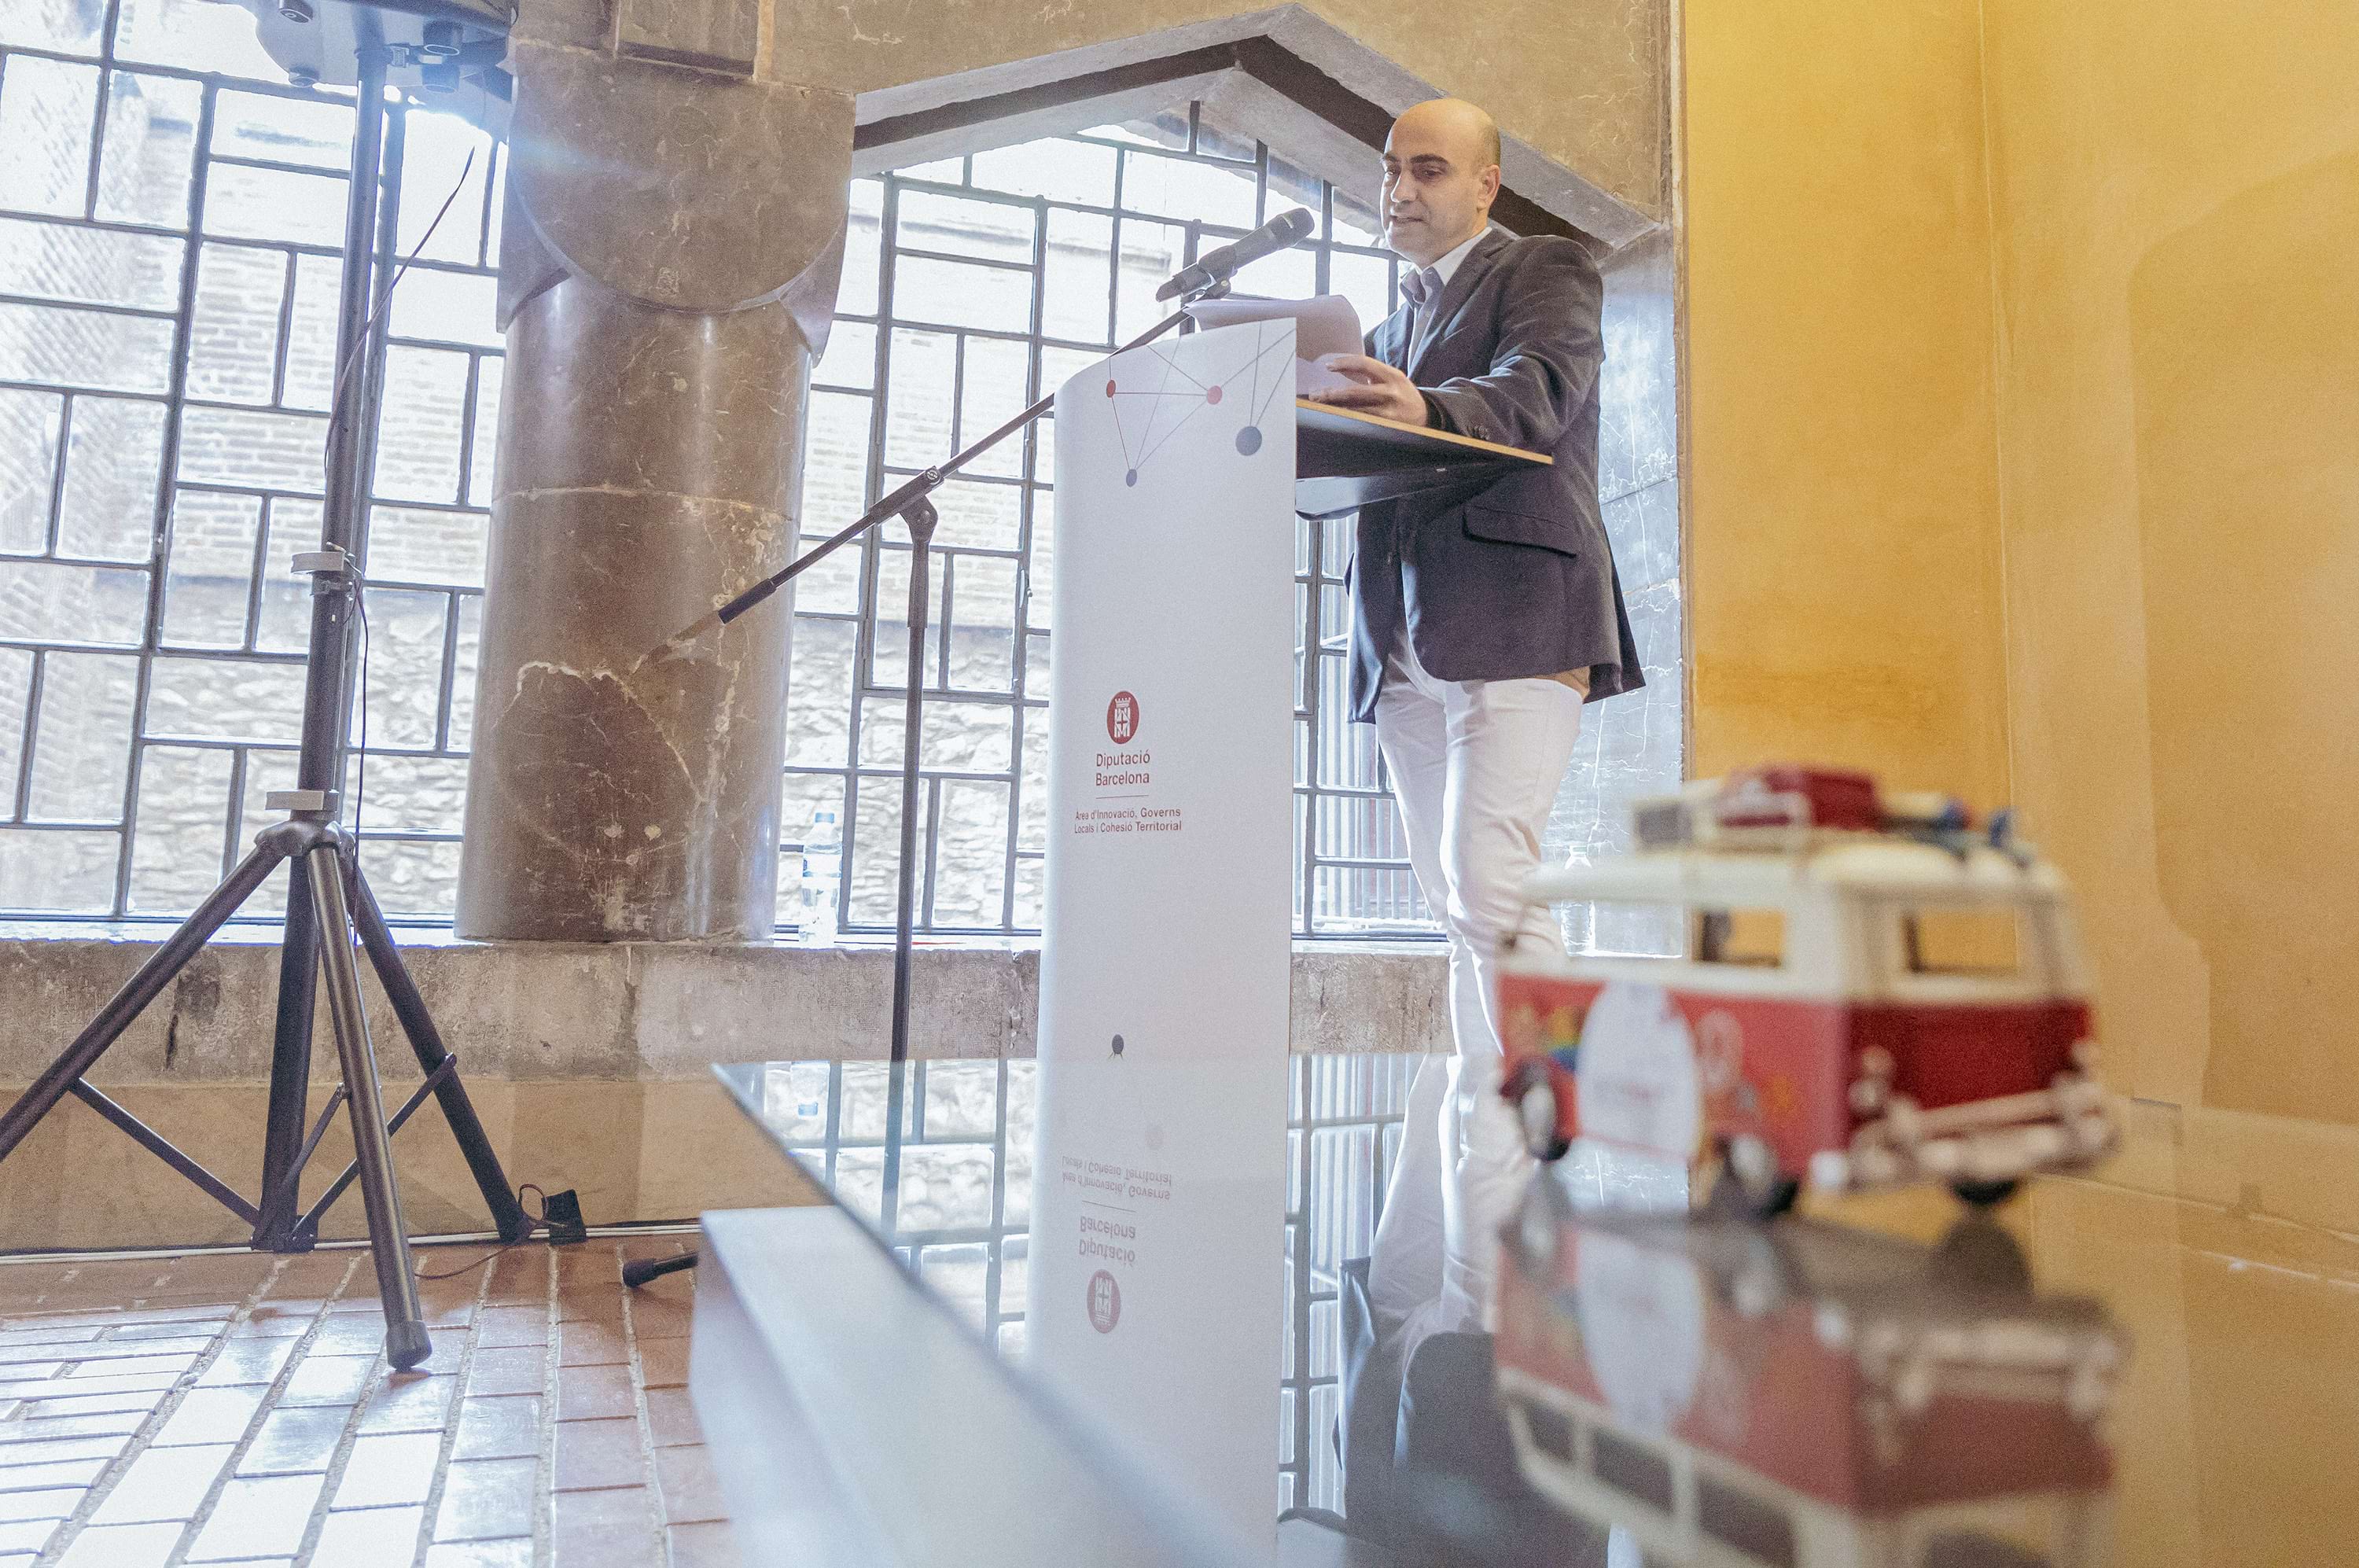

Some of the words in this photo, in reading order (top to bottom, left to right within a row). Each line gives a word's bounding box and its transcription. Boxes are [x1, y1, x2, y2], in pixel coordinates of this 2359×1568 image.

[1096, 749, 1150, 769] Diputació
[1095, 771, 1150, 786] Barcelona
[1140, 807, 1181, 818] Governs
[1074, 823, 1095, 834] Locals
[1100, 821, 1132, 833] Cohesió
[1135, 820, 1182, 831] Territorial
